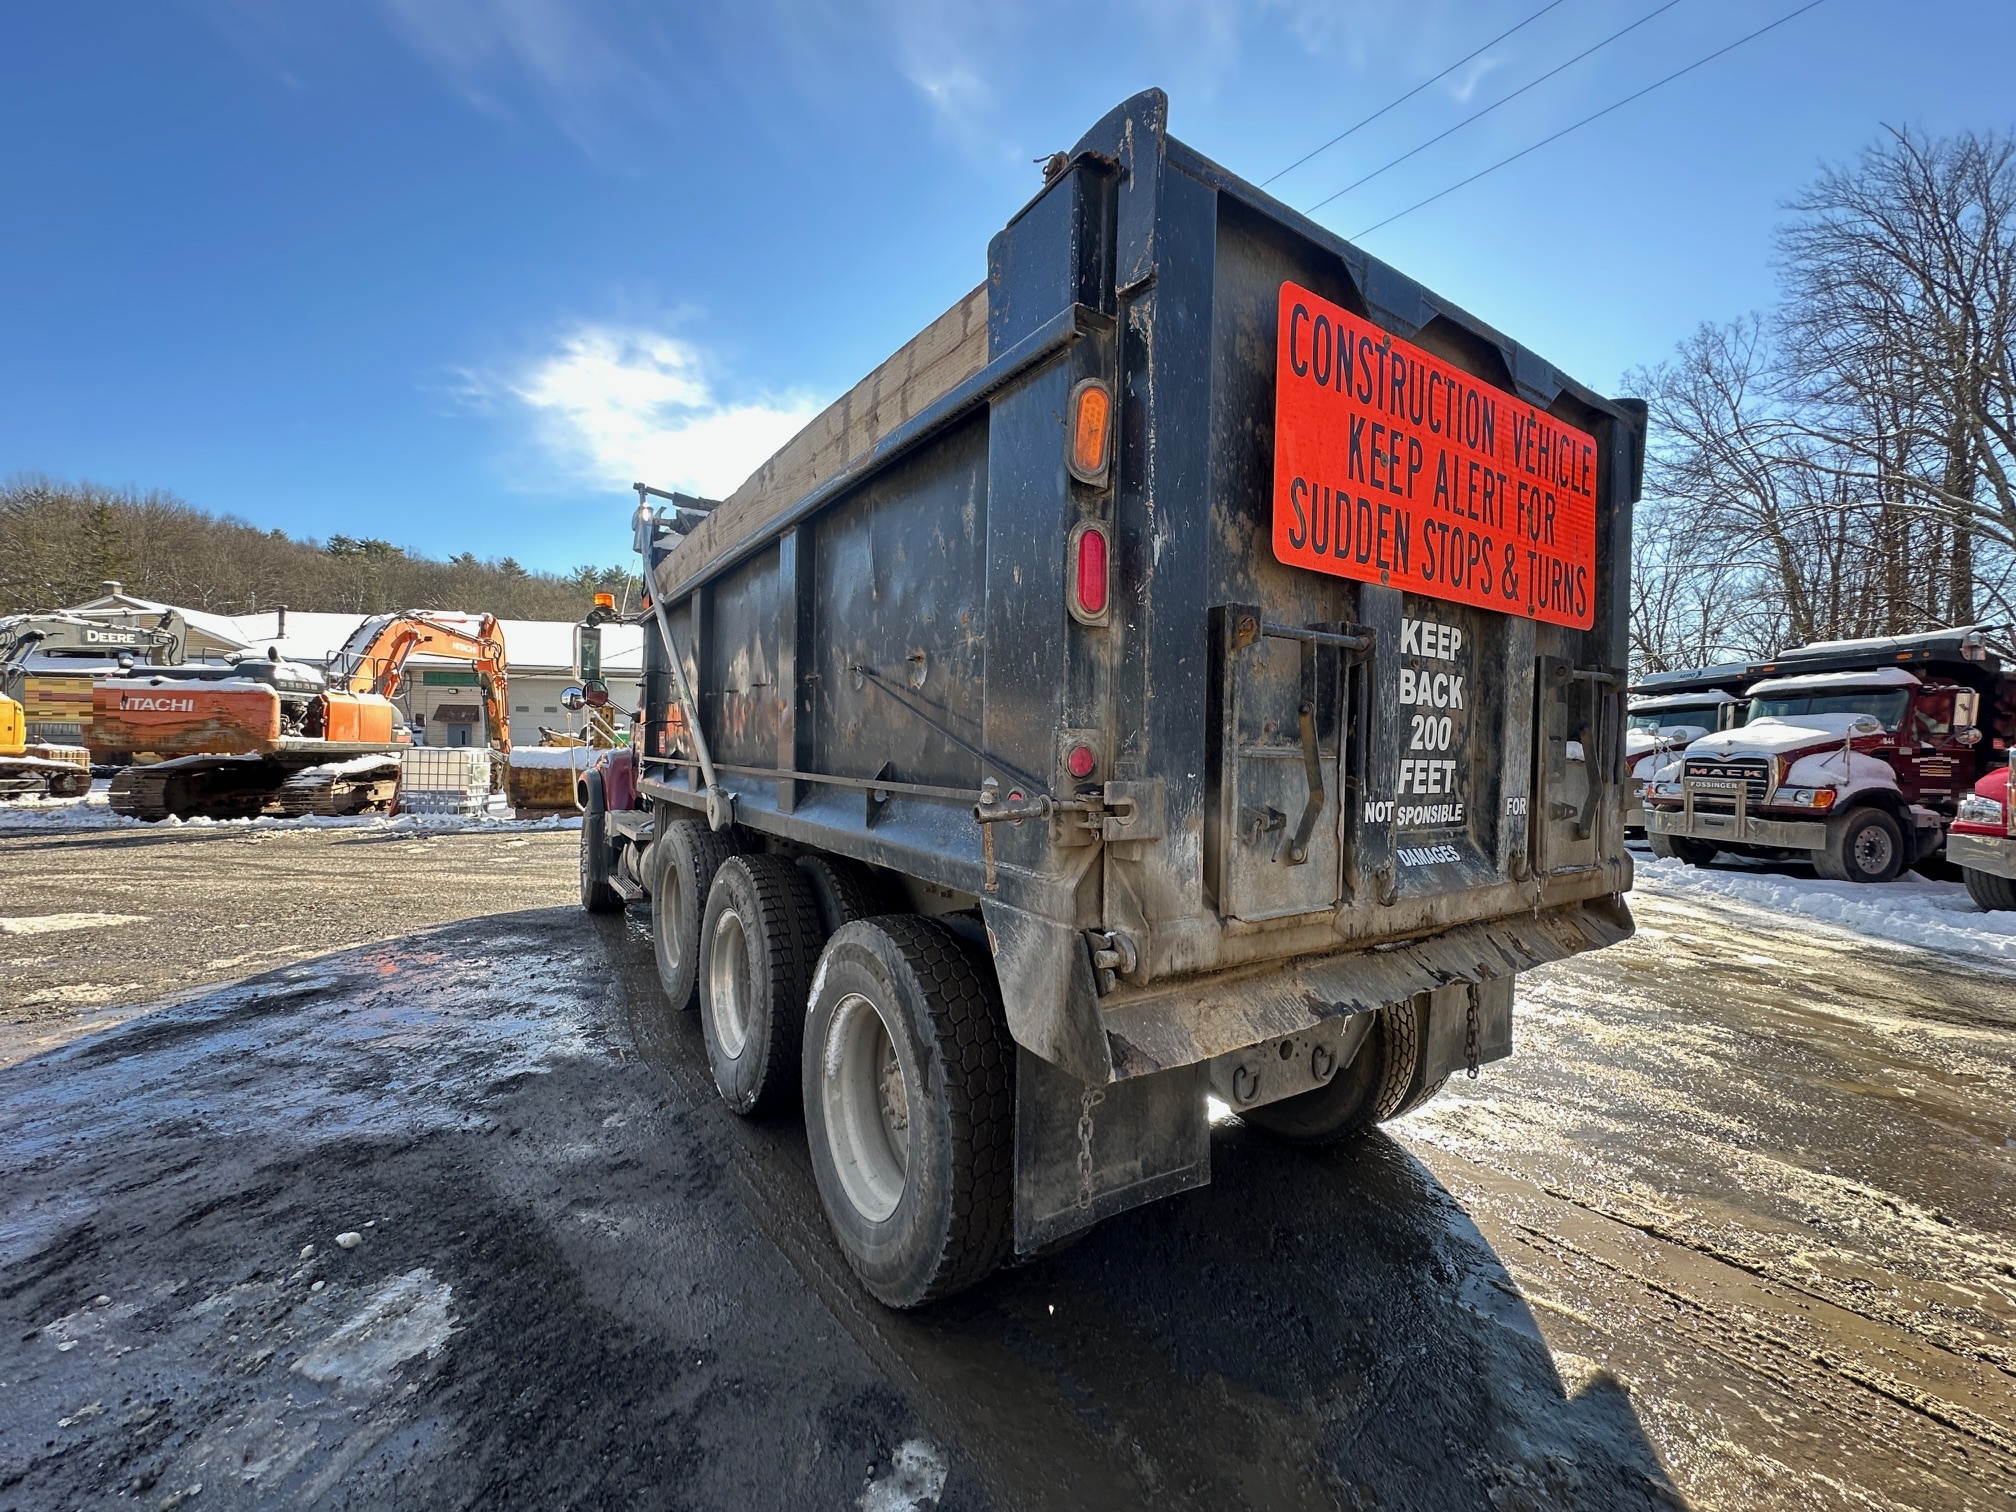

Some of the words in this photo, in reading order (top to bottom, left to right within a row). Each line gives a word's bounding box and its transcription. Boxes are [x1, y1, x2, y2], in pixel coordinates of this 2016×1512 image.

[1290, 303, 1496, 457] CONSTRUCTION
[1512, 411, 1592, 497] VEHICLE
[1348, 413, 1423, 499] KEEP
[1433, 450, 1507, 530] ALERT
[1517, 482, 1556, 546] FOR
[1289, 477, 1410, 574] SUDDEN
[1422, 518, 1493, 594] STOPS
[1502, 543, 1520, 600] &
[1527, 551, 1587, 617] TURNS
[86, 629, 136, 643] DEERE
[1401, 618, 1462, 662] KEEP
[119, 697, 194, 712] ITACHI
[1400, 668, 1463, 710] BACK
[1410, 716, 1452, 751] 200
[1397, 759, 1456, 795] FEET
[1689, 767, 1764, 778] MACK
[1364, 801, 1395, 824] NOT
[1506, 797, 1527, 816] FOR
[1397, 844, 1461, 867] DAMAGES
